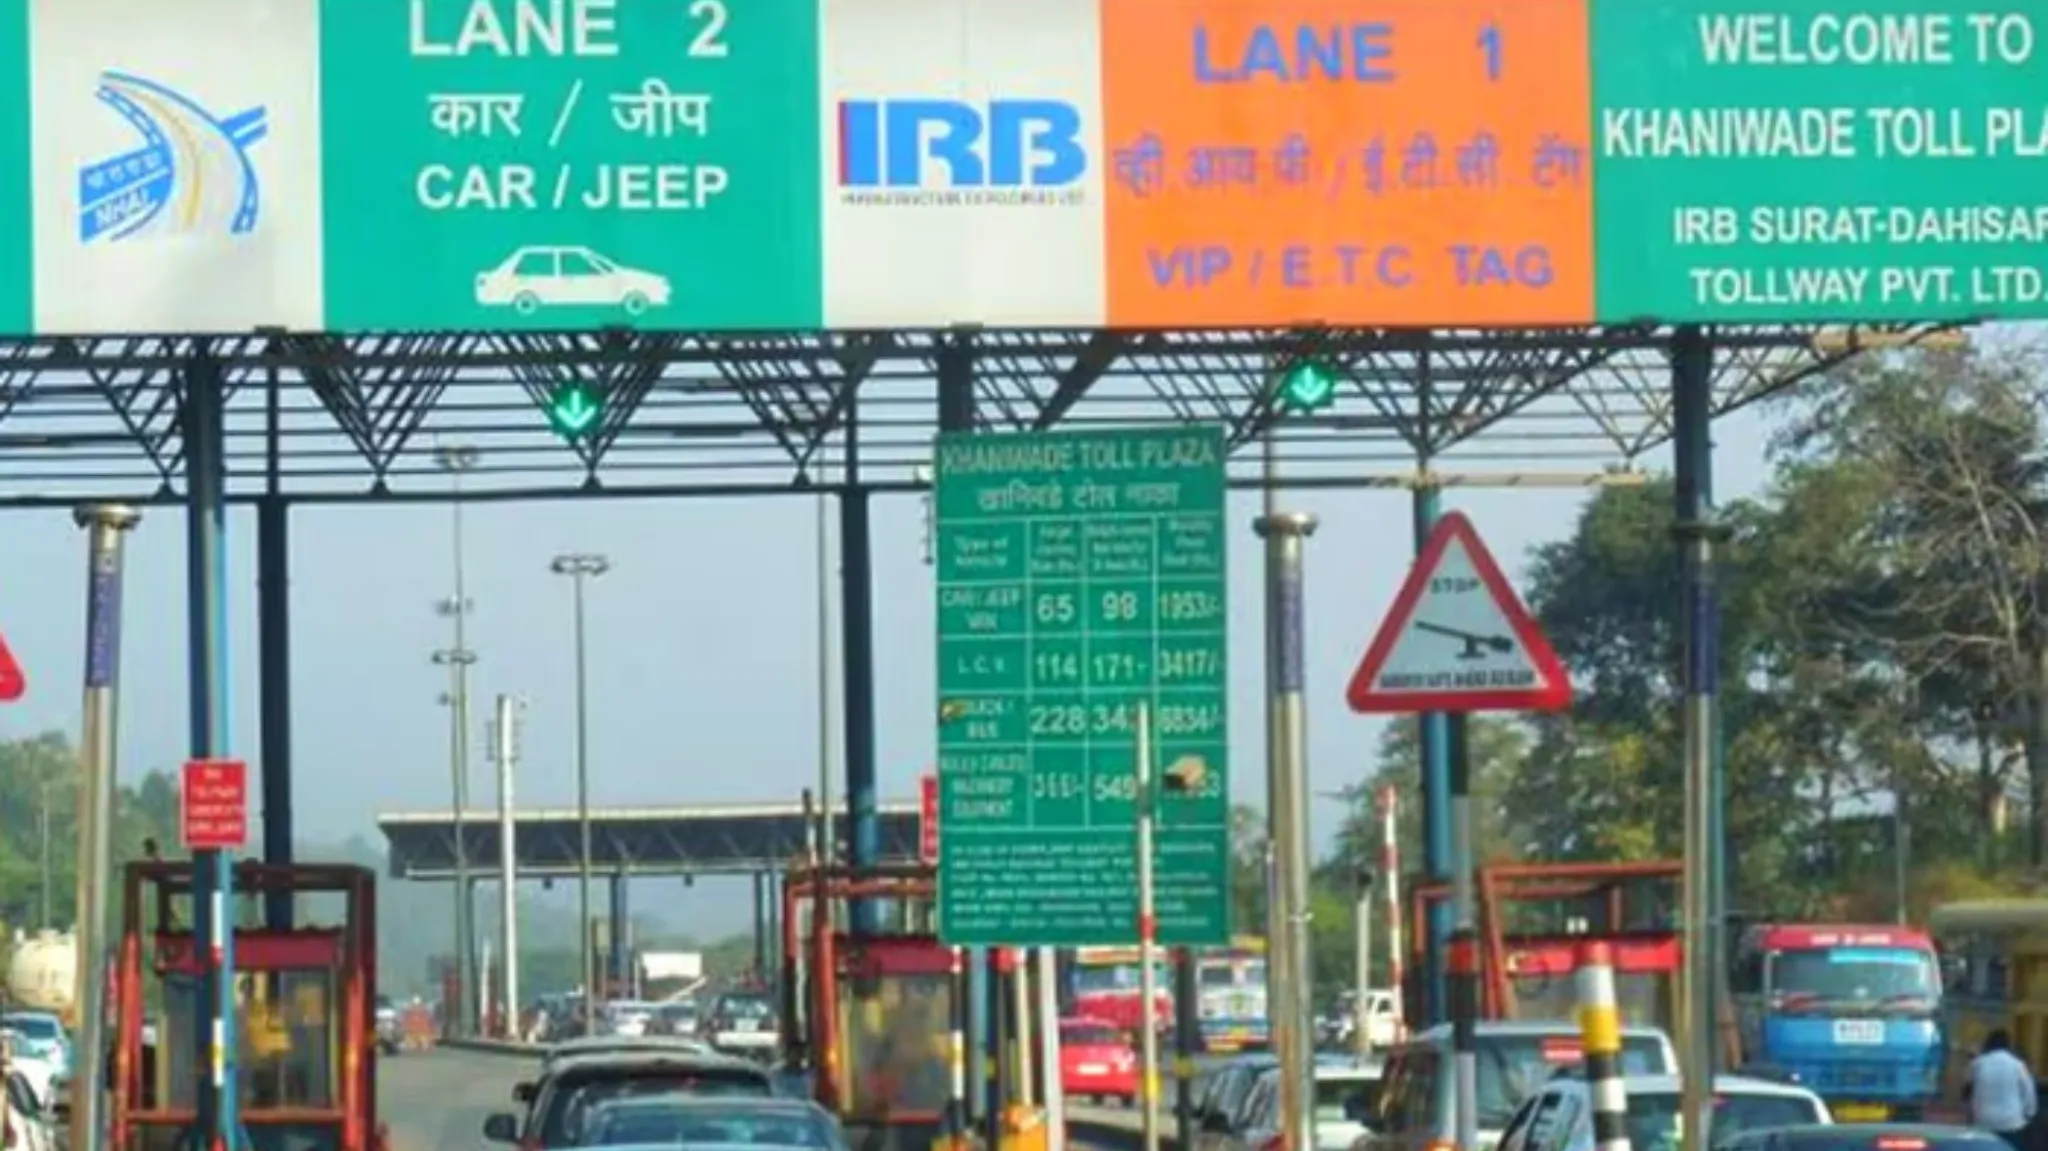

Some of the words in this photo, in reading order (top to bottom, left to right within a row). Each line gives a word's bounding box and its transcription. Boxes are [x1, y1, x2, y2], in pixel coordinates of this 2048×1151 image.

[410, 0, 620, 56] LANE
[686, 0, 730, 57] 2
[1700, 14, 1953, 64] WELCOME
[1968, 15, 2033, 63] TO
[1192, 25, 1395, 82] LANE
[1476, 24, 1503, 82] 1
[427, 93, 524, 137] कार
[608, 77, 713, 137] जीप
[838, 100, 1087, 187] IRB
[1603, 108, 1856, 157] KHANIWADE
[1868, 108, 1975, 157] TOLL
[415, 164, 537, 209] CAR
[581, 164, 730, 209] JEEP
[1674, 207, 1739, 244] IRB
[1147, 246, 1232, 287] VIP
[1446, 245, 1555, 288] TAG
[1690, 267, 1867, 304] TOLLWAY
[1881, 268, 1960, 303] PVT.
[942, 442, 1074, 474] KHANIWADE
[1080, 440, 1135, 469] TOLL
[1141, 438, 1216, 467] PLAZA
[1037, 594, 1074, 622] 65
[1102, 591, 1138, 620] 98
[1036, 653, 1078, 680] 114
[1030, 704, 1086, 734] 228
